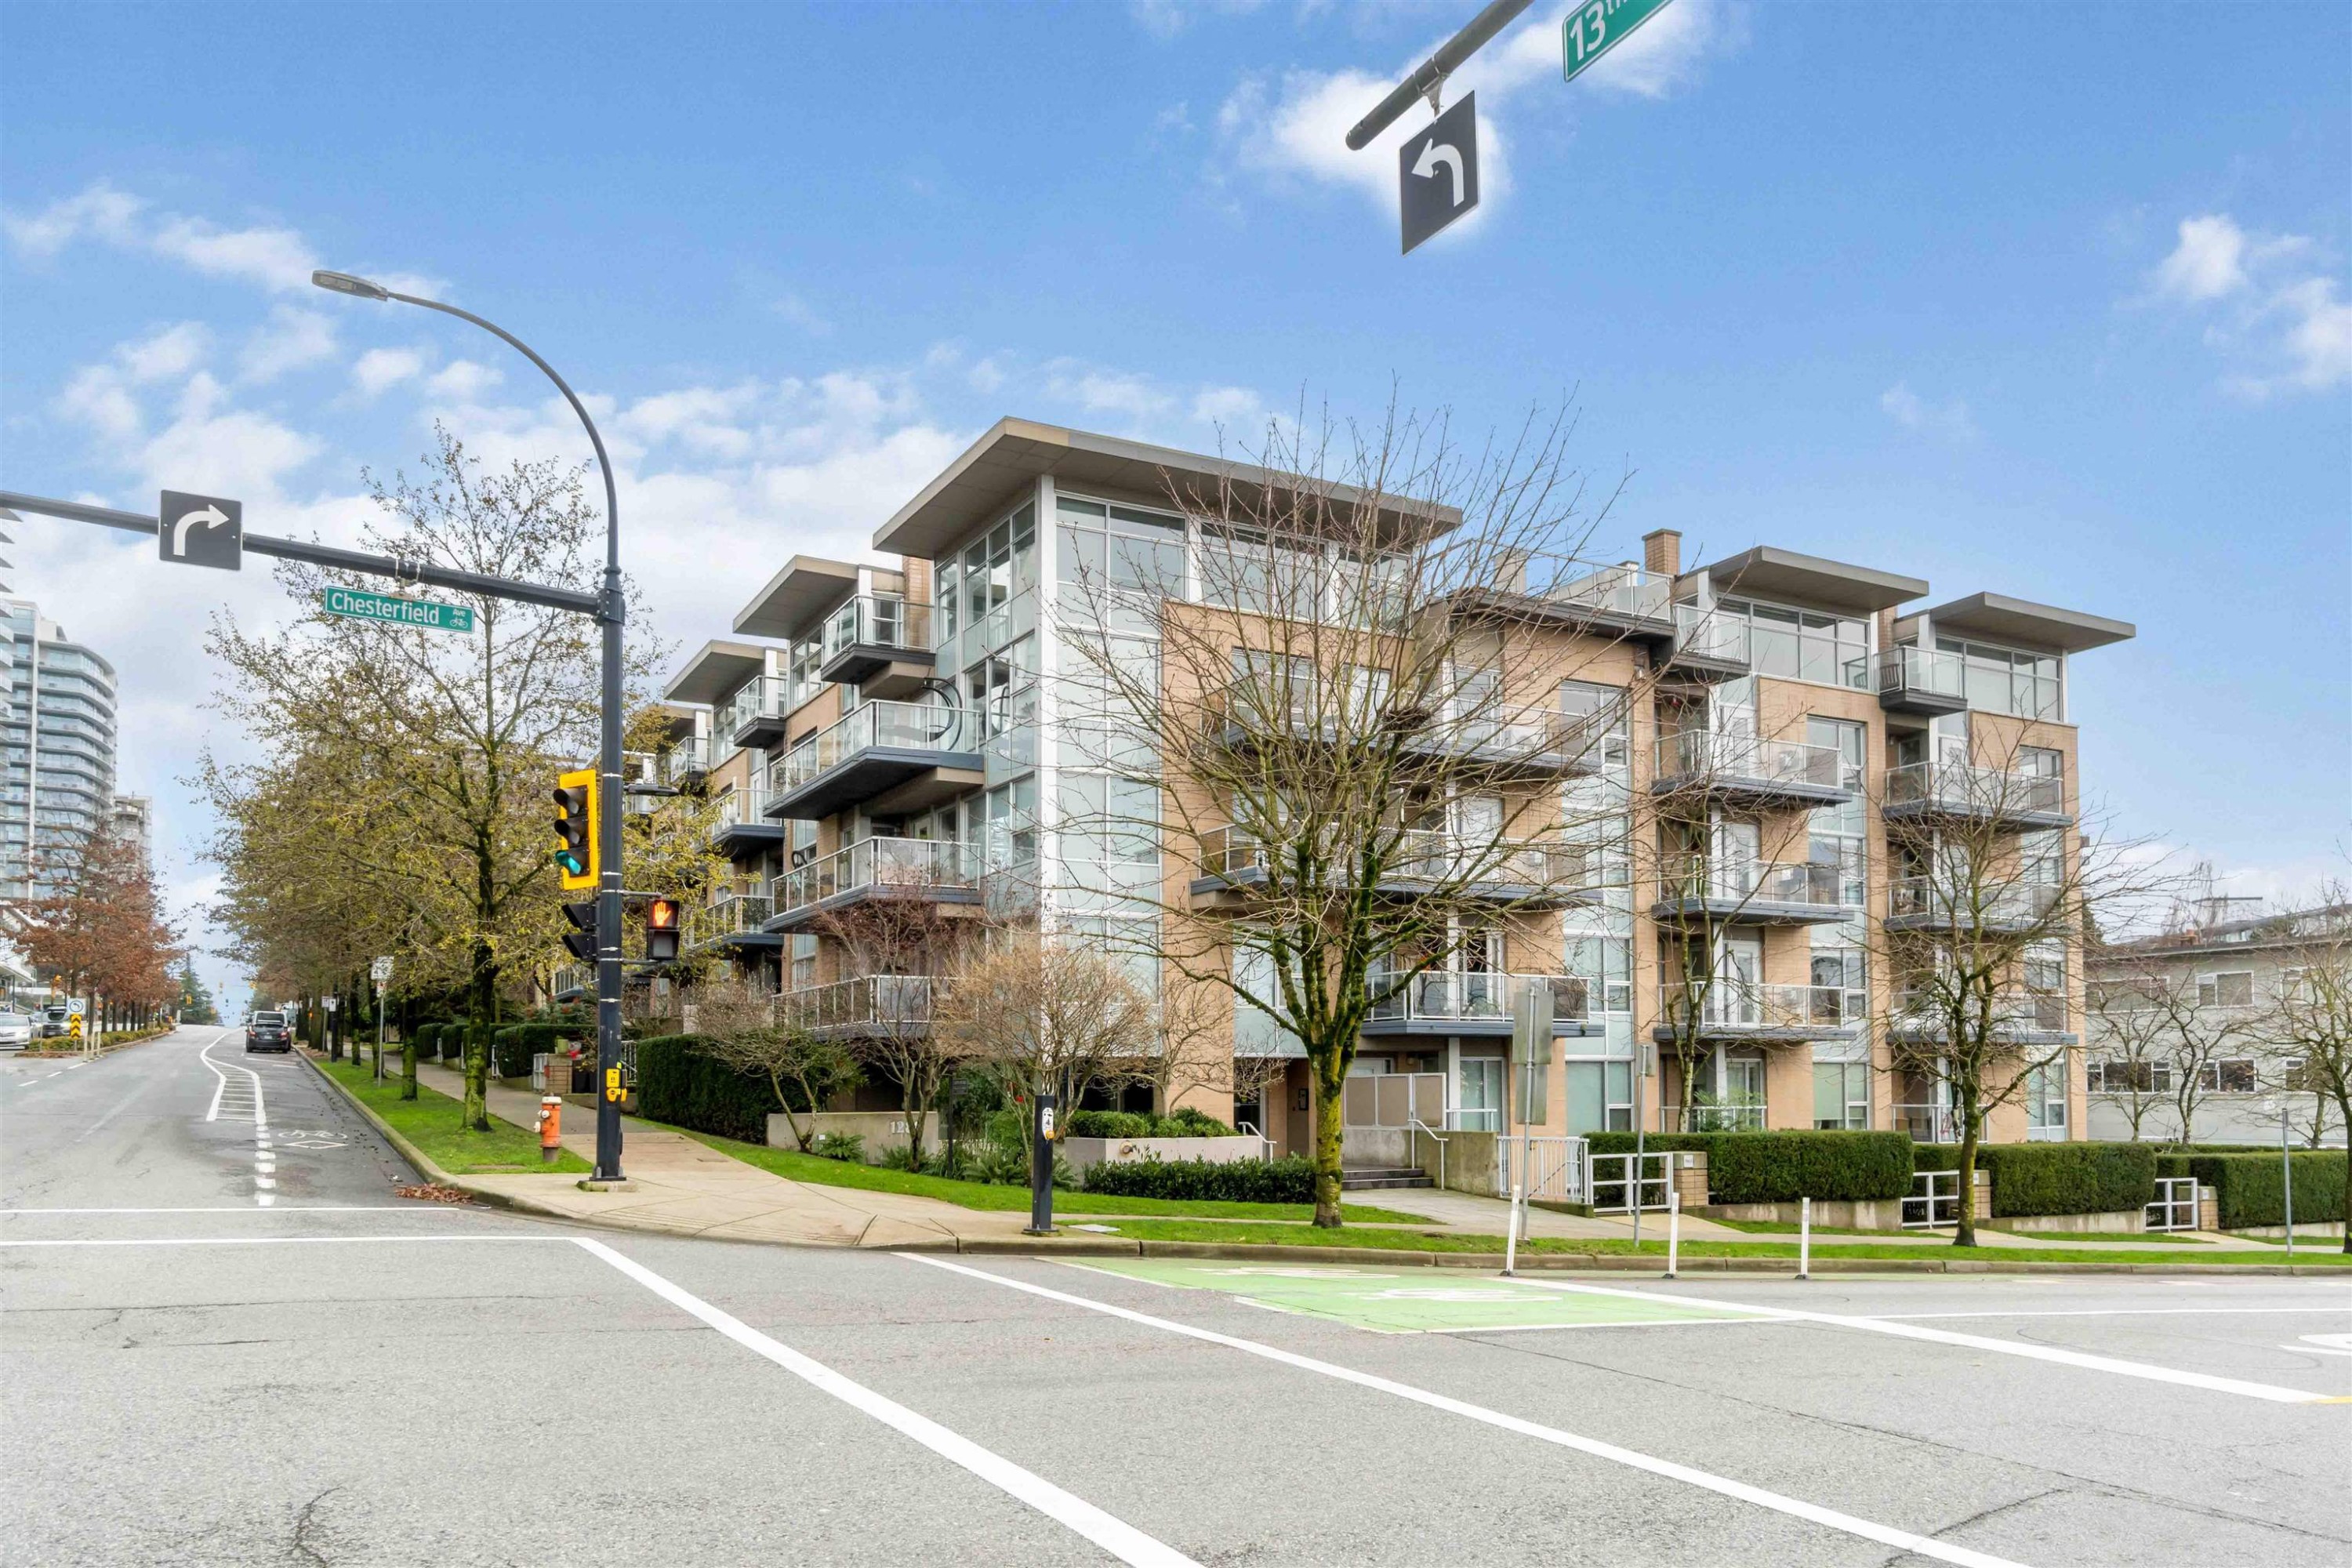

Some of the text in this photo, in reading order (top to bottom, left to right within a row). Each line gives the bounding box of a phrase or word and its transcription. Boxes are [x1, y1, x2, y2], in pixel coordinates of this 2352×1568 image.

[332, 593, 466, 625] Chesterfield Ave
[890, 1120, 918, 1134] 12
